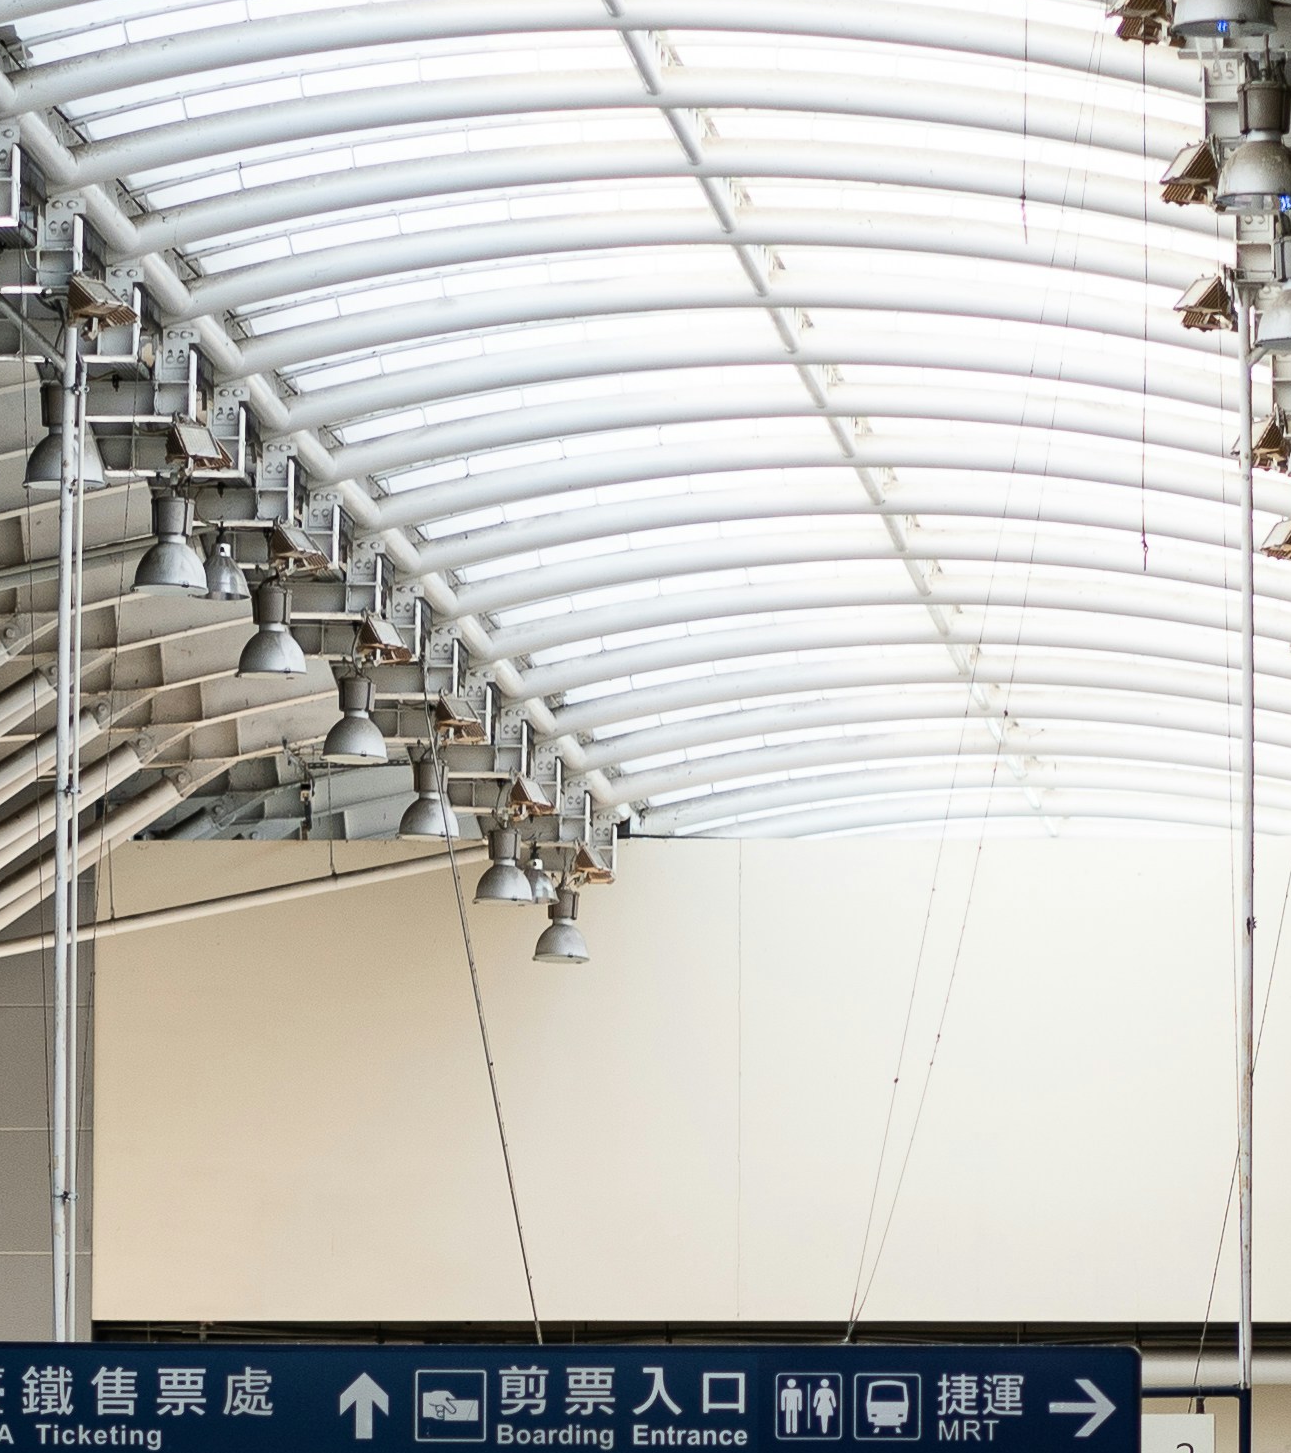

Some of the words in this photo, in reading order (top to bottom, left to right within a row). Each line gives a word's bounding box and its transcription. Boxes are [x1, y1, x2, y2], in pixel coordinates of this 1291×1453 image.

[498, 1365, 747, 1416] 剪票入口
[937, 1373, 1025, 1416] 捷運
[35, 1423, 163, 1451] Ticketing
[496, 1423, 615, 1451] Boarding
[632, 1424, 748, 1446] Entrance
[938, 1419, 1000, 1442] MRT
